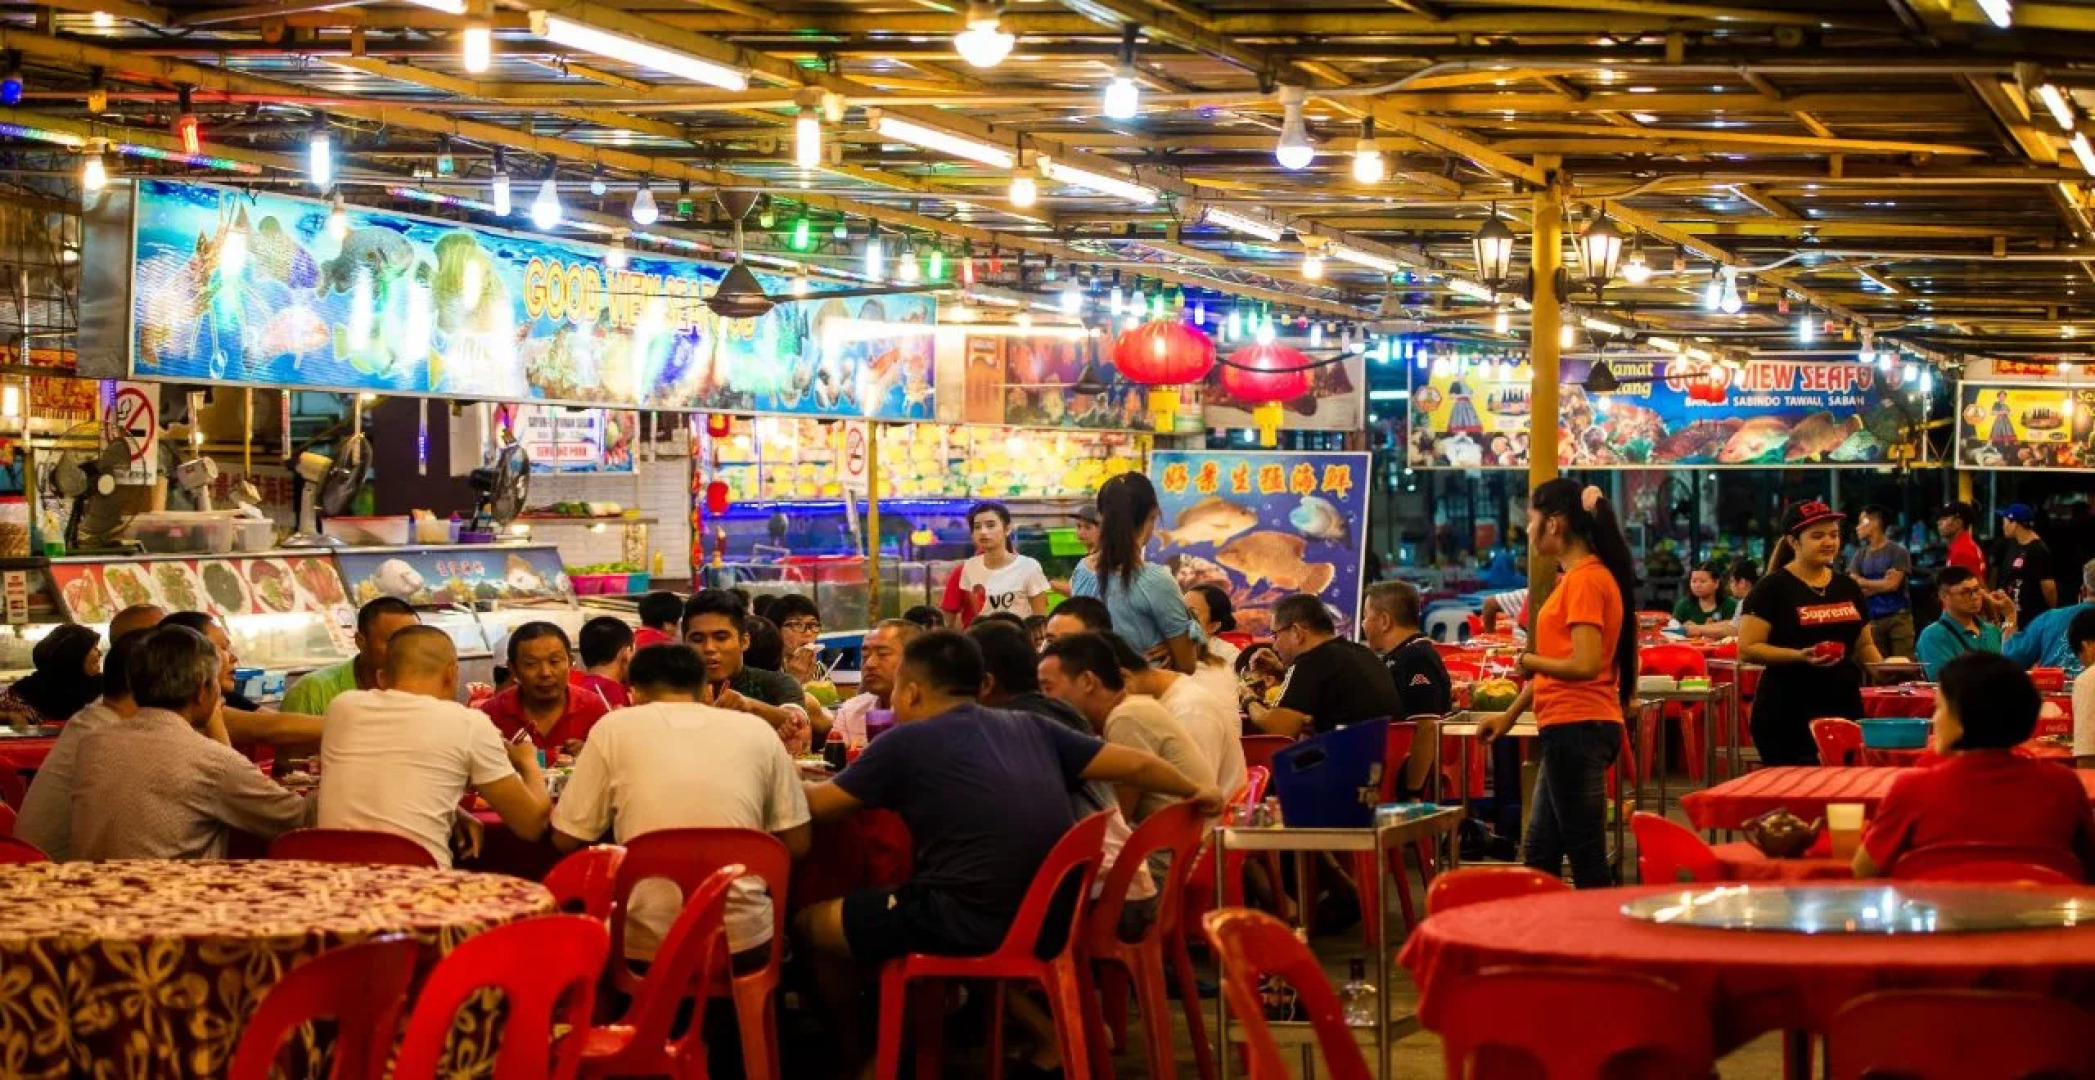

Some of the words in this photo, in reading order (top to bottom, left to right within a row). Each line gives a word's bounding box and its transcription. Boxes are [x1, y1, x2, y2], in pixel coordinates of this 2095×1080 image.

[525, 258, 601, 323] GOOD
[665, 275, 757, 339] SEAF
[1591, 358, 1654, 376] lamat
[1801, 362, 1904, 393] SEAFO
[1733, 395, 1781, 407] SABINDO
[1828, 396, 1865, 406] SABAH
